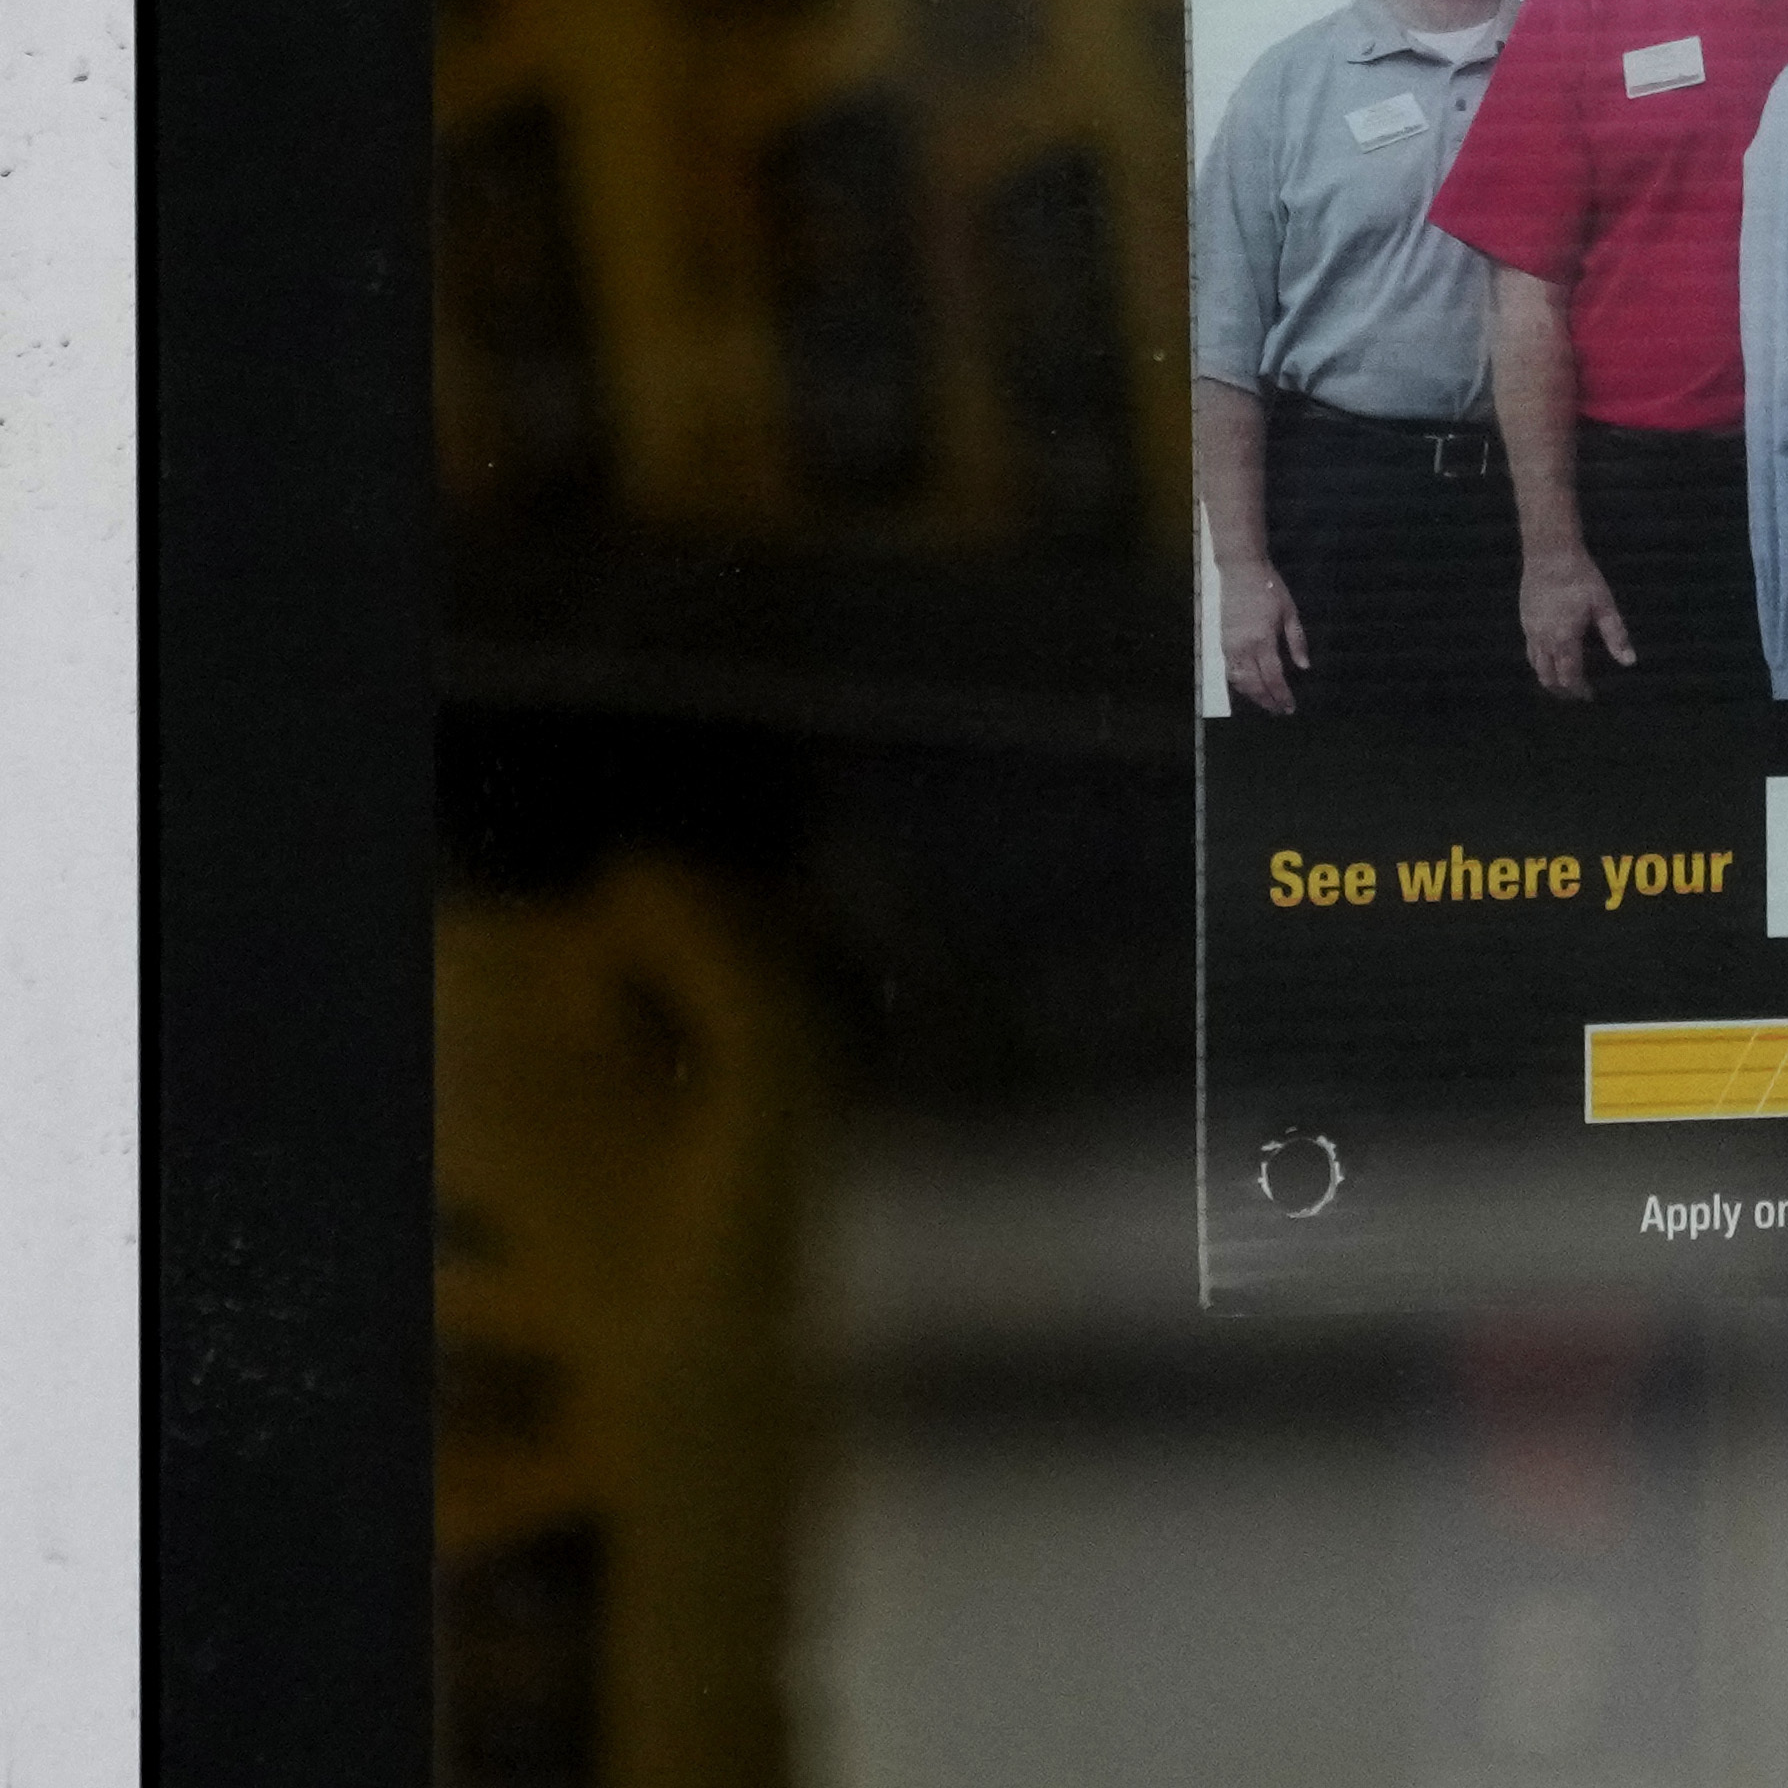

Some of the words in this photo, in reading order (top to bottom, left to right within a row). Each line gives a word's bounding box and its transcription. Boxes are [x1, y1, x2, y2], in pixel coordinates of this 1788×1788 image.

[1270, 850, 1377, 908] See
[1397, 845, 1582, 903] where
[1602, 847, 1734, 910] your
[1640, 1192, 1743, 1241] Apply
